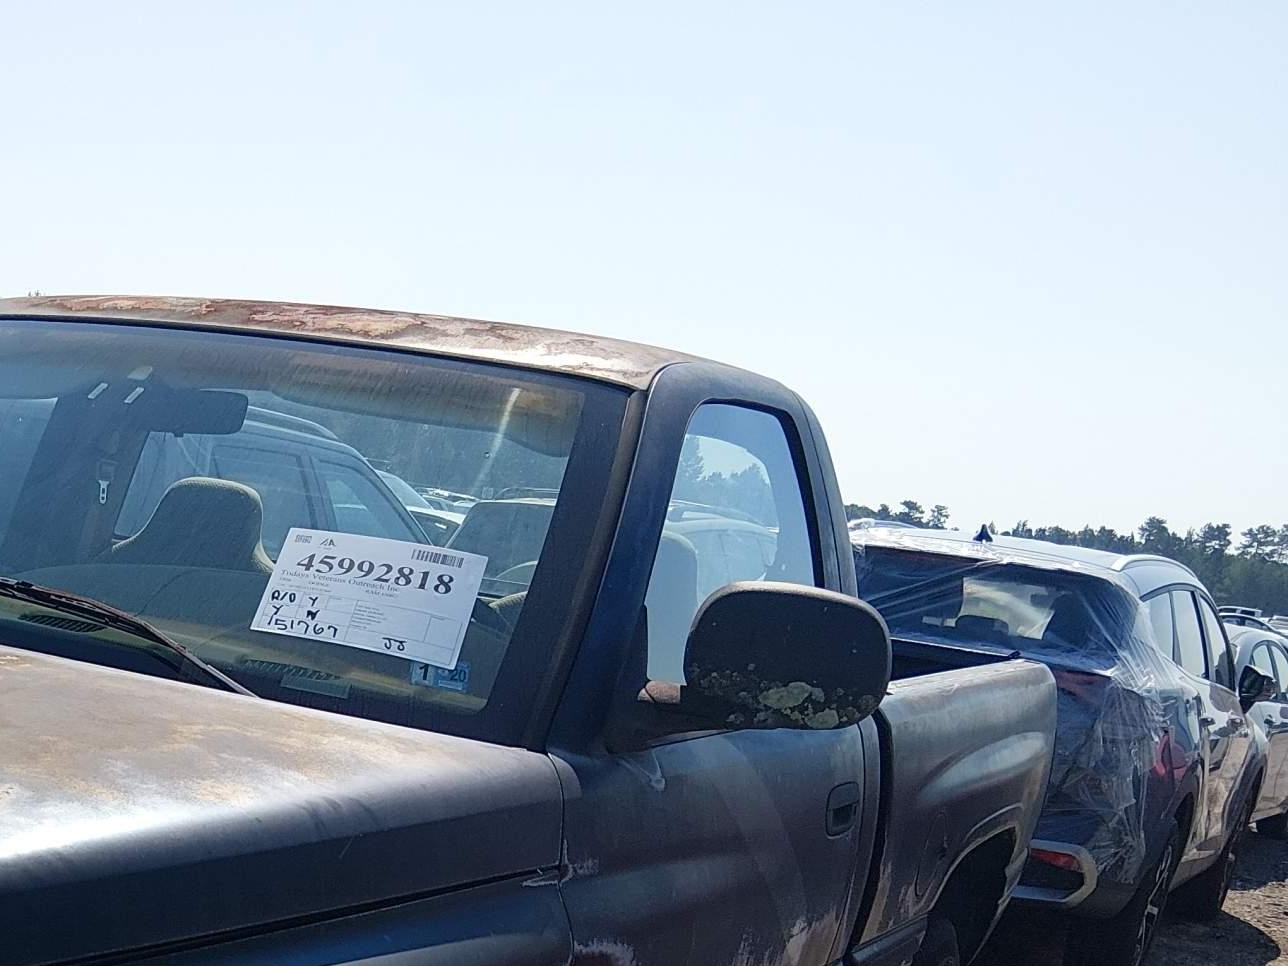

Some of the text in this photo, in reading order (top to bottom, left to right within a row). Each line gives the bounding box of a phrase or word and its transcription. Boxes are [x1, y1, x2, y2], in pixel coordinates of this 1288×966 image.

[297, 553, 455, 595] 45992818
[312, 573, 346, 584] Veterans
[347, 579, 385, 591] Outreach
